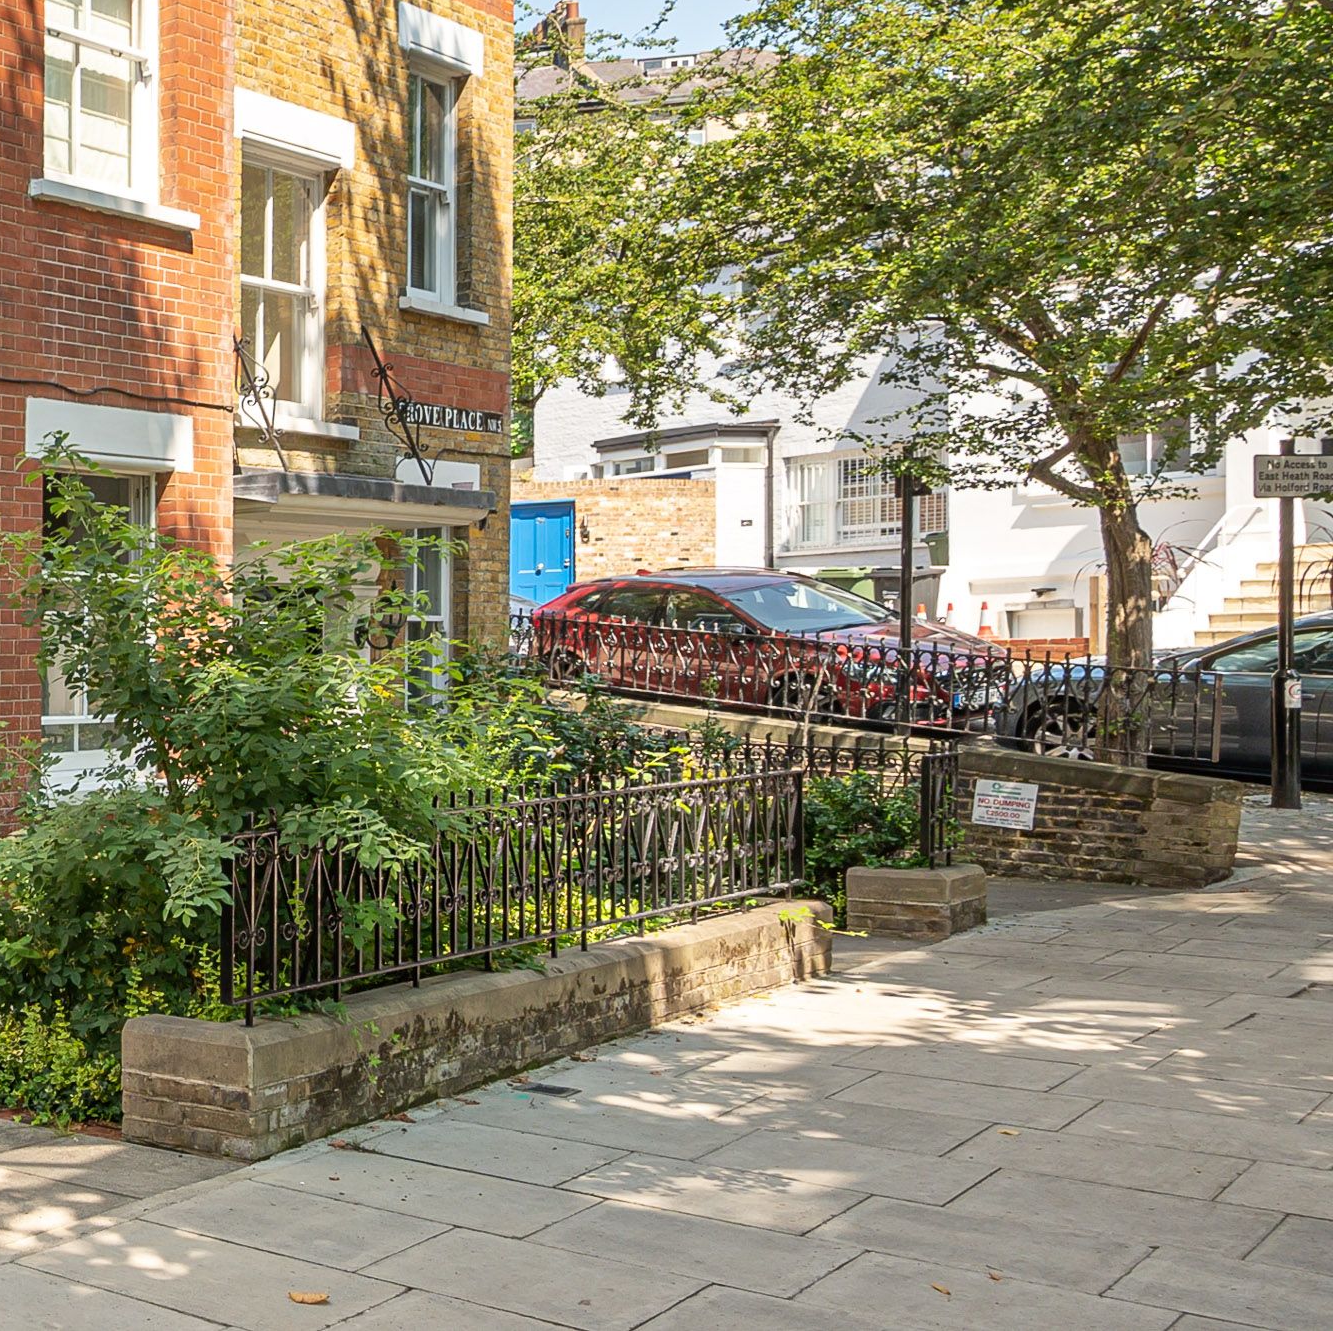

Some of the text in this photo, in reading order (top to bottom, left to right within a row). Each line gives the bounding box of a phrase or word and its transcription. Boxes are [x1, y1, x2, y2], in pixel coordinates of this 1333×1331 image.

[445, 408, 483, 431] PLACE
[1267, 460, 1328, 469] No Access to
[1258, 471, 1279, 480] East
[1282, 471, 1309, 480] Heath
[1258, 483, 1271, 492] via
[1275, 482, 1309, 492] Holford
[978, 797, 990, 805] NO
[993, 799, 1030, 809] DUMPING
